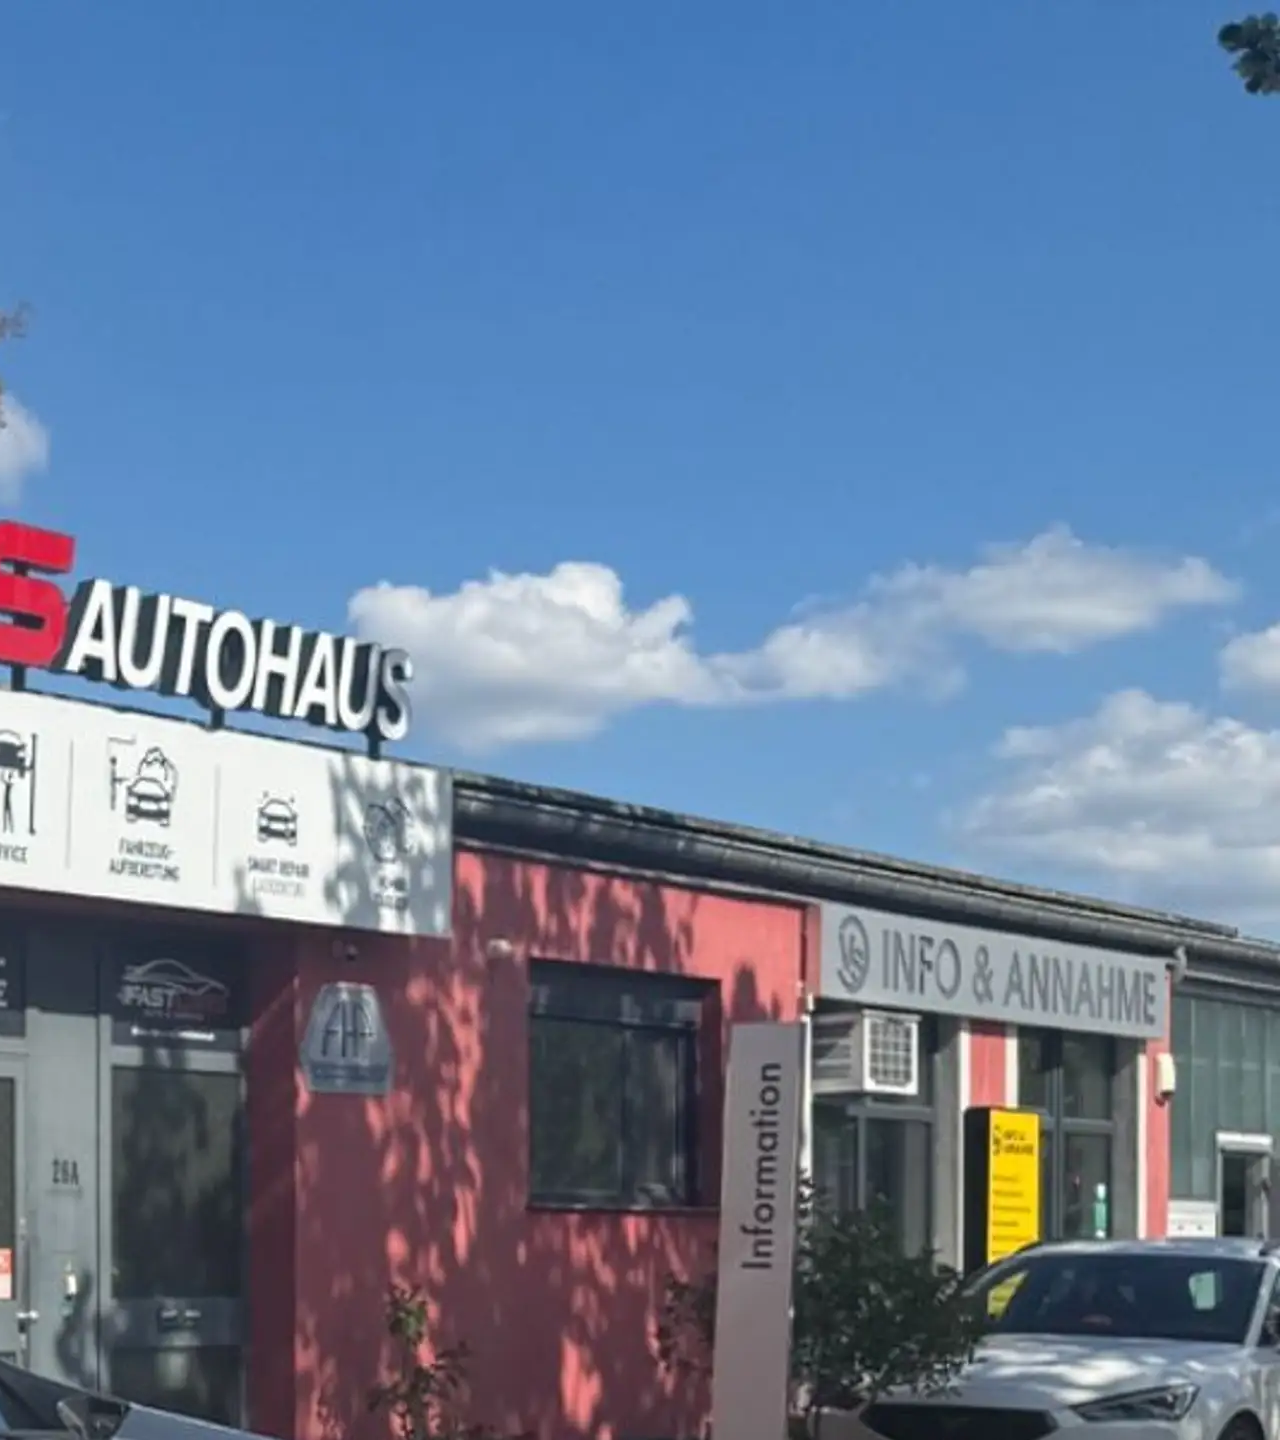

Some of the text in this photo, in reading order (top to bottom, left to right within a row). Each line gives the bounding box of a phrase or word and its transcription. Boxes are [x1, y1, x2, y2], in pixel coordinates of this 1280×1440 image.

[65, 578, 412, 741] AUTOHAUS
[882, 928, 1157, 1027] INFO & ANNAHME
[741, 1061, 782, 1271] Information
